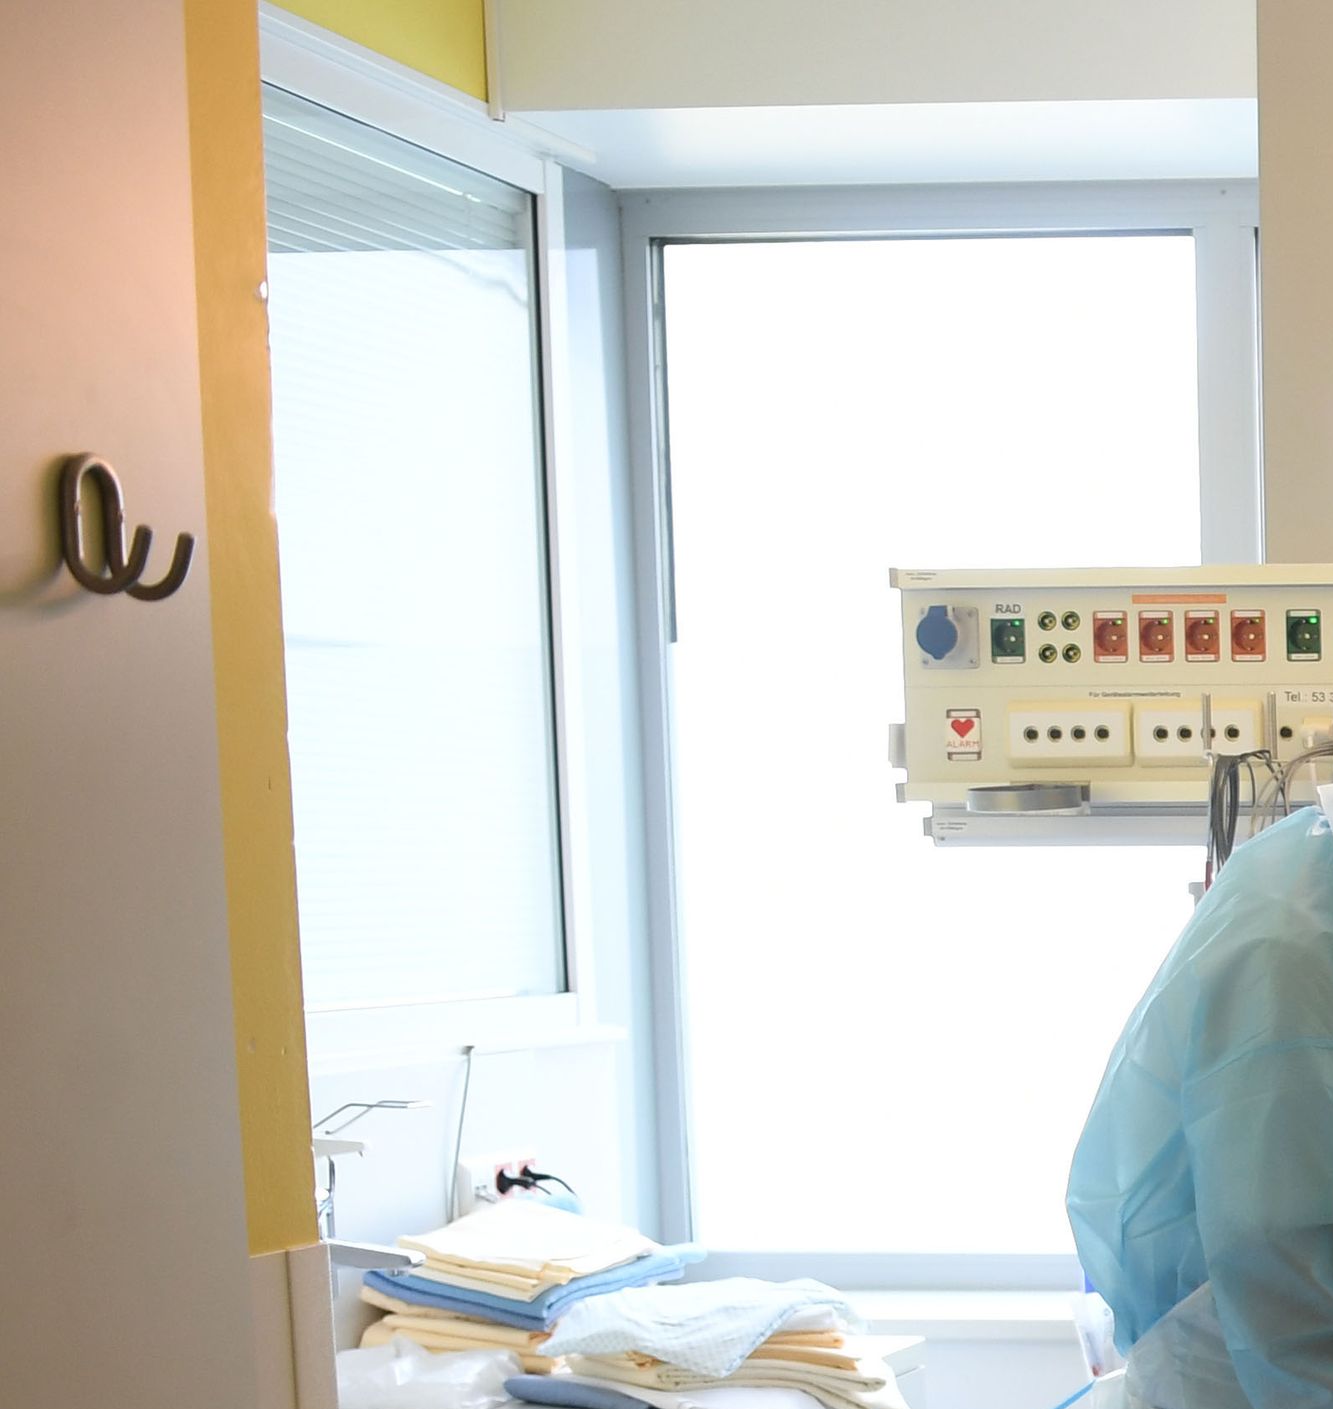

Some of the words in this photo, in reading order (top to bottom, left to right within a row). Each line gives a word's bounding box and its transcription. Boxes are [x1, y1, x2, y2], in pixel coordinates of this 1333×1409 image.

[995, 603, 1022, 614] RAD
[1311, 691, 1326, 702] 53
[946, 740, 981, 749] ALARM
